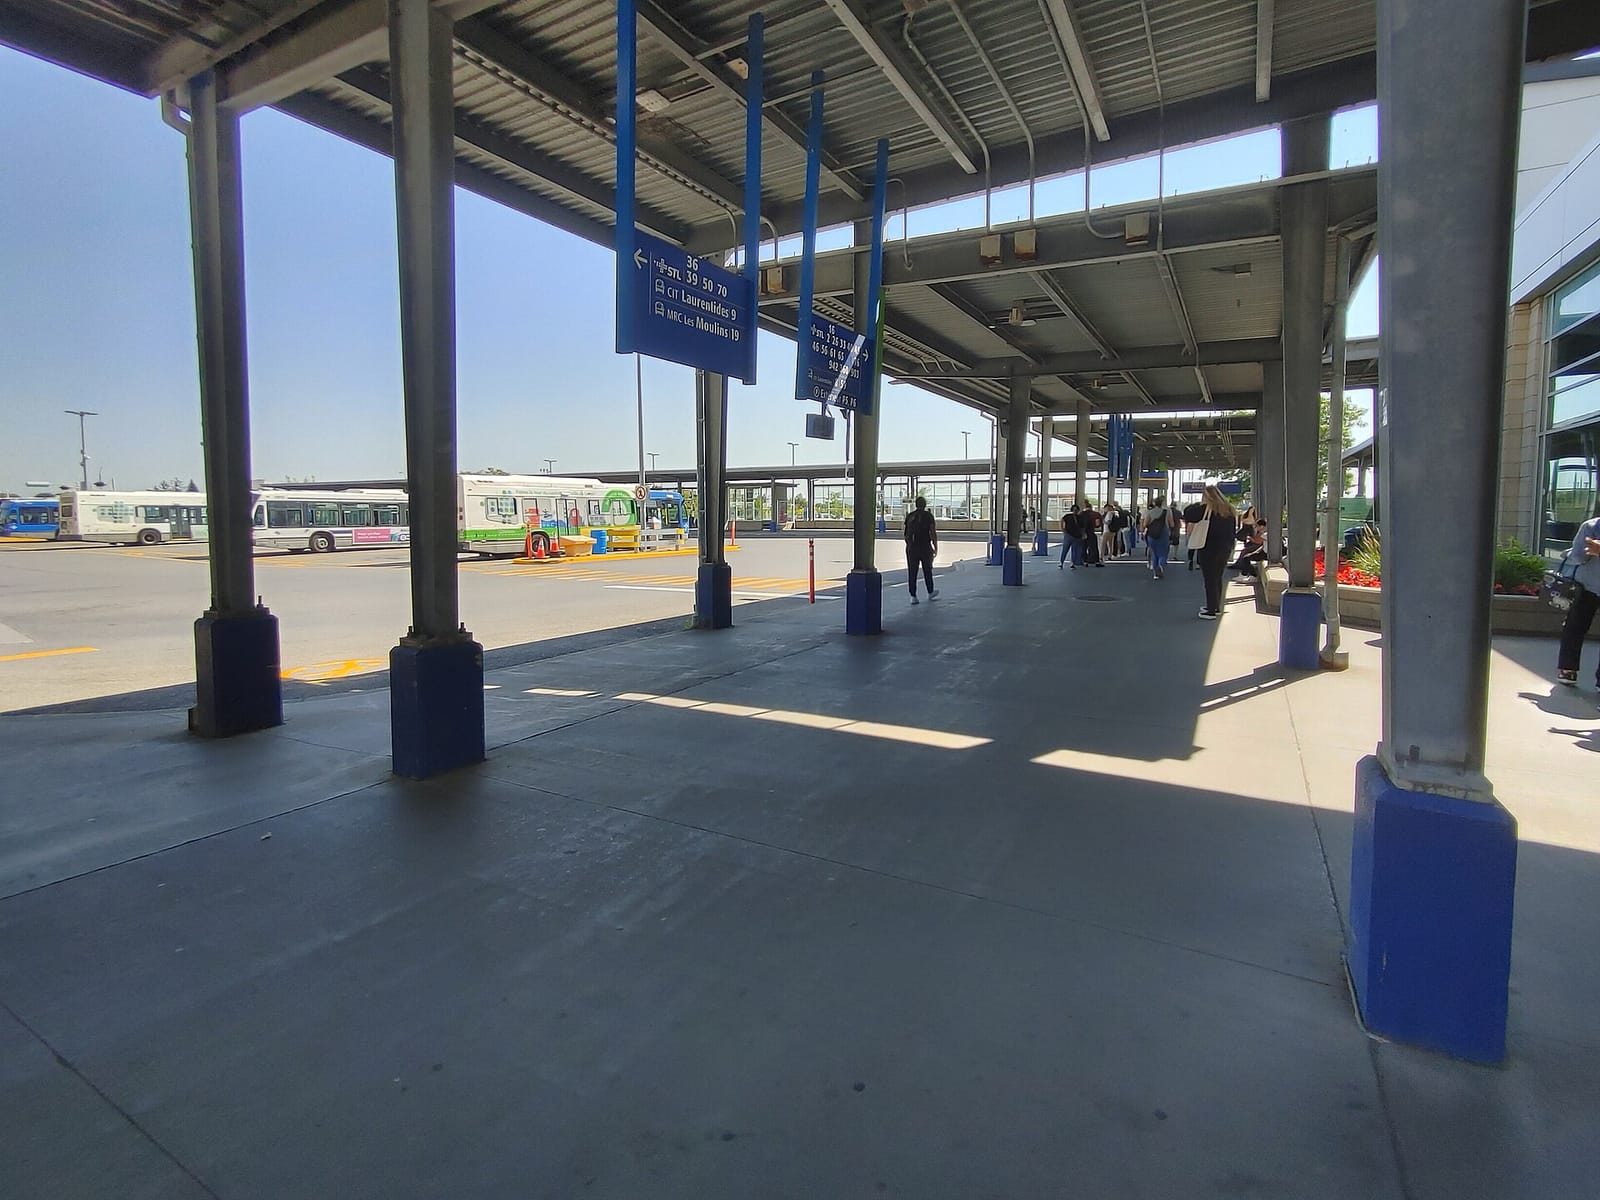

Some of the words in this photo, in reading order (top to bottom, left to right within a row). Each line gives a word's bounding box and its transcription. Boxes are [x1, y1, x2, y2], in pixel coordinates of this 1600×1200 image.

[686, 255, 699, 271] 36
[667, 267, 682, 280] STL
[686, 270, 698, 286] 39
[702, 277, 714, 292] 50
[717, 284, 728, 298] 70
[667, 287, 679, 300] CIT
[681, 289, 729, 319] Laurentides
[731, 309, 737, 321] 9
[666, 309, 683, 323] MRC
[683, 315, 695, 327] Les
[695, 316, 729, 338] Moulins
[730, 328, 740, 342] 19
